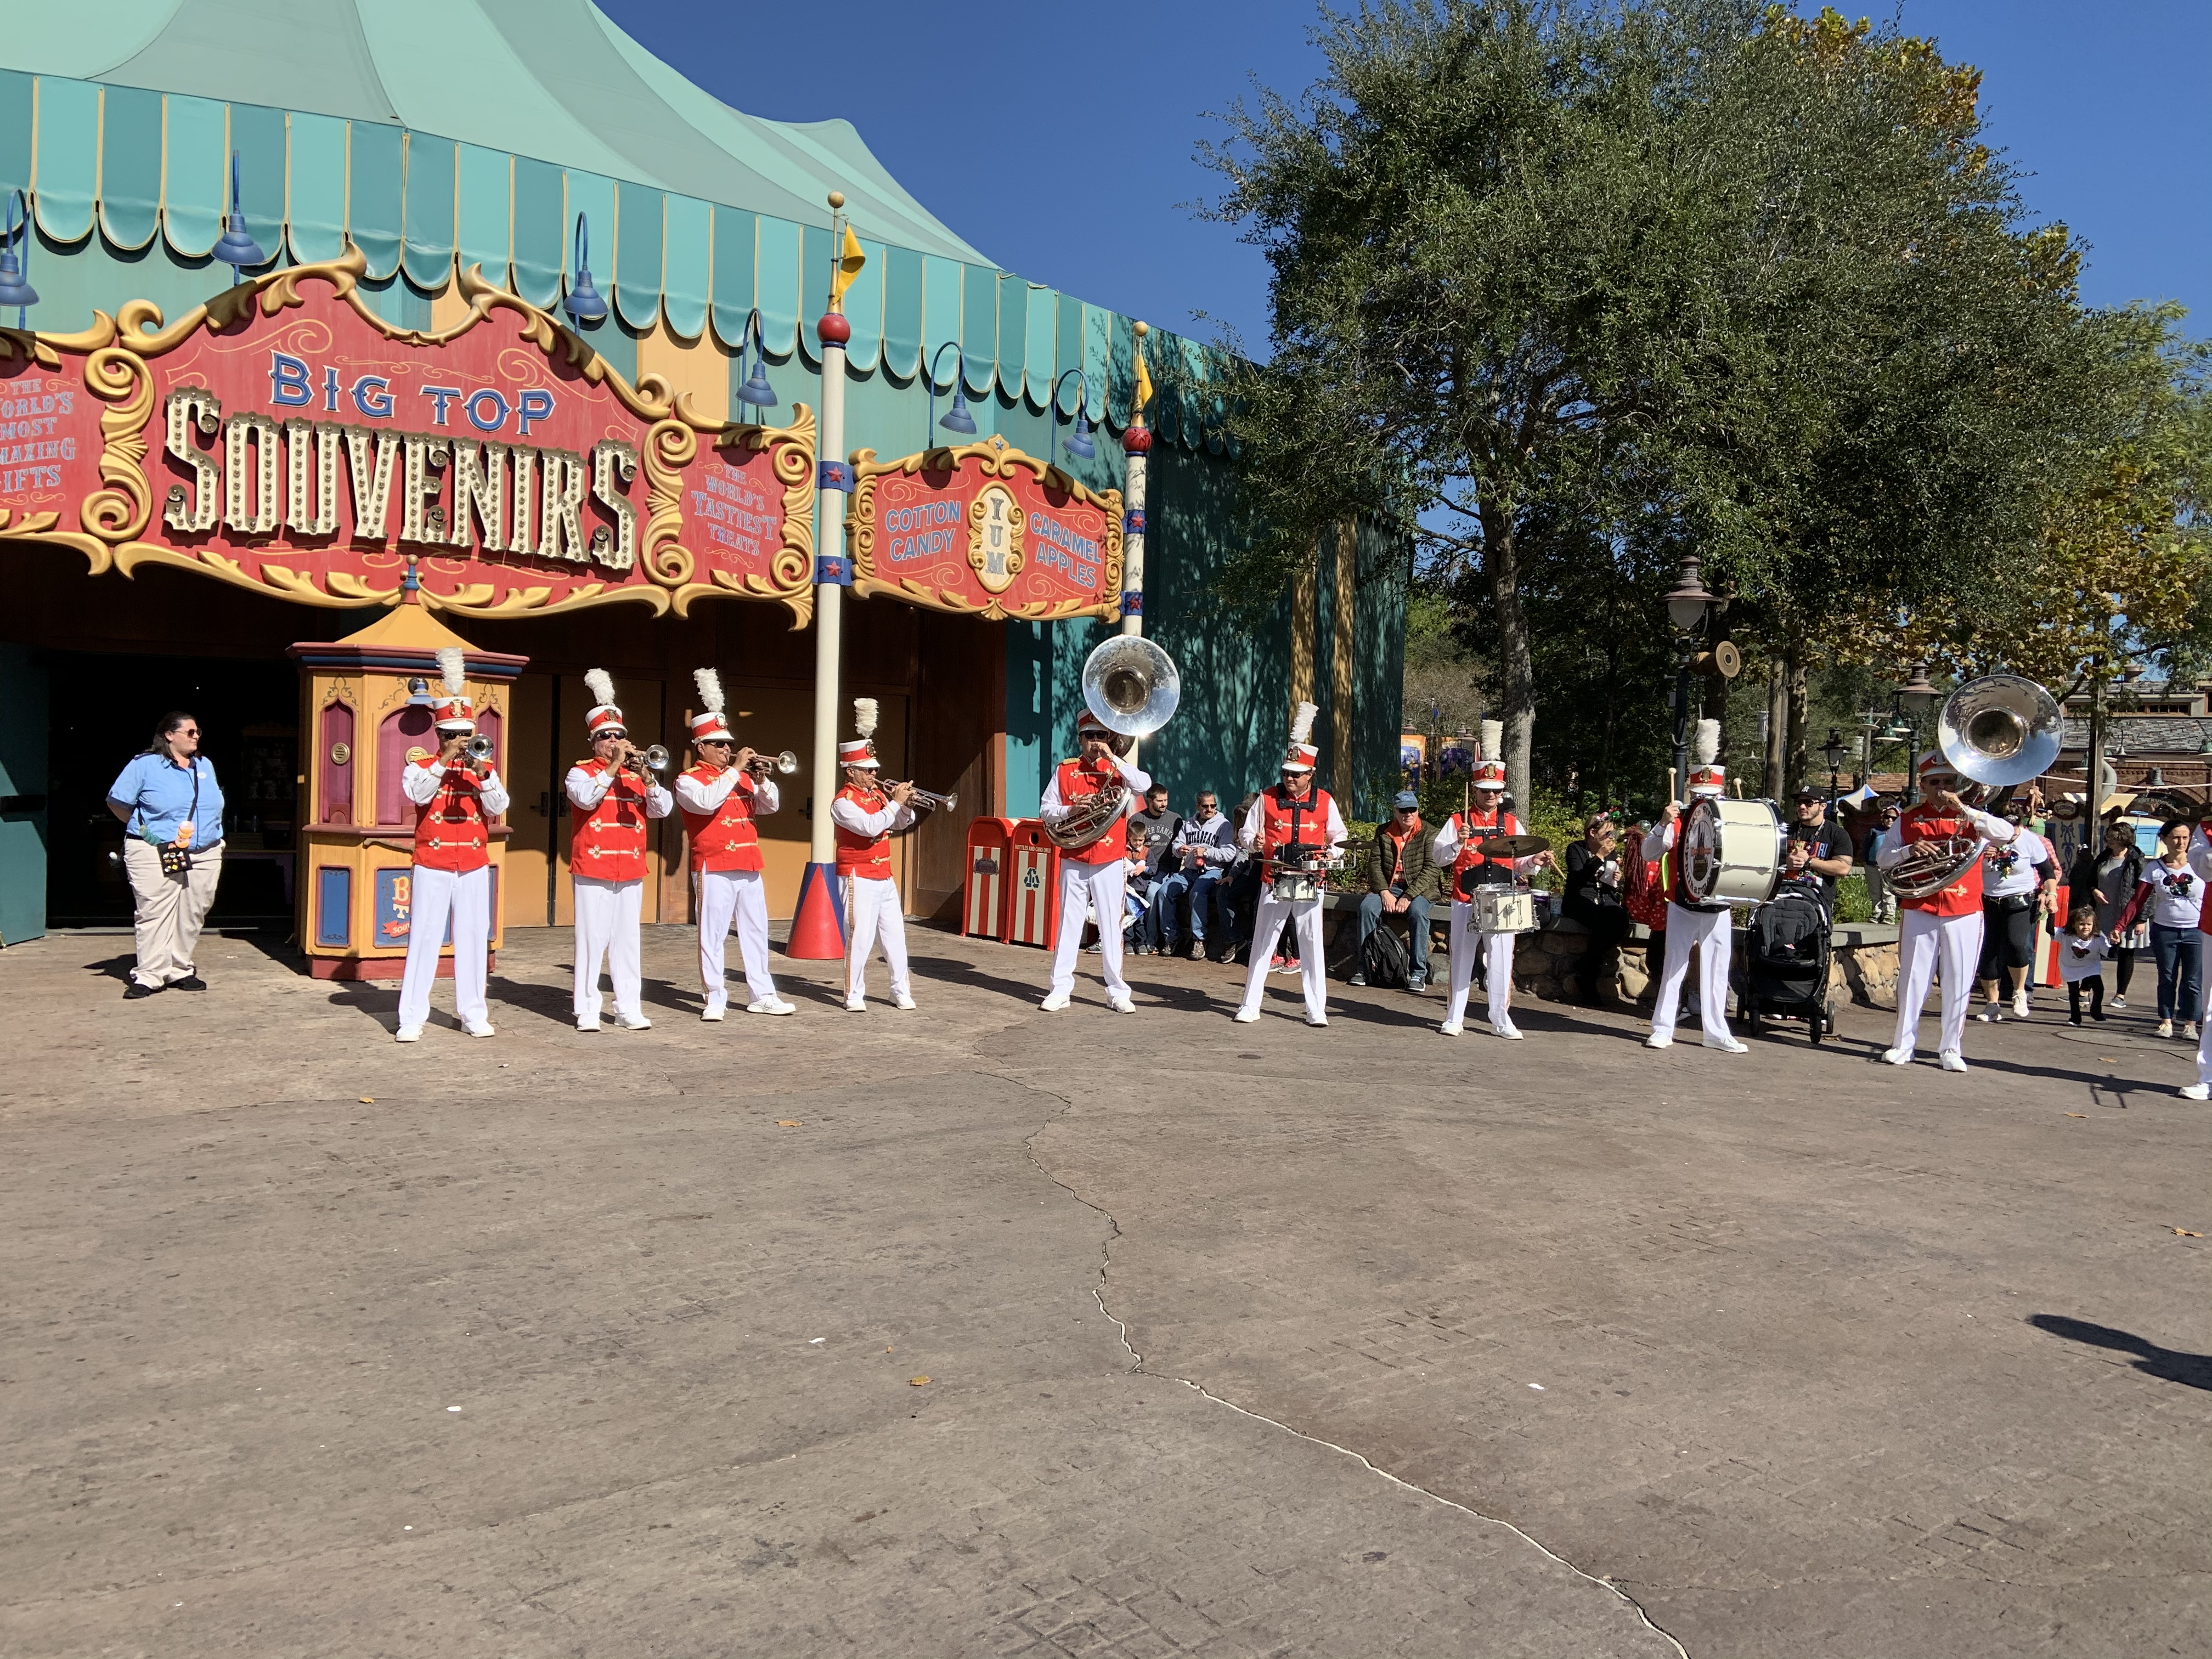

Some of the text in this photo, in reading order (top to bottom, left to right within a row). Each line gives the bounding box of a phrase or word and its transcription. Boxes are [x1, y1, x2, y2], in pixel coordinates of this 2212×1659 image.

[10, 379, 42, 395] THE
[268, 349, 557, 436] BIG TOP
[0, 392, 74, 419] ORLD'S
[0, 417, 57, 441] MOST
[0, 465, 61, 493] IFTS
[164, 386, 638, 572] SOUVENIRS
[724, 464, 747, 485] THE
[705, 475, 764, 511] WORLD'S
[691, 490, 777, 540] TASTIEST
[885, 500, 961, 533] COTTON
[708, 522, 759, 556] TREATS
[890, 528, 956, 562] CANDY
[985, 496, 1005, 575] YUM
[1030, 512, 1101, 564] CARAMEL
[1035, 541, 1096, 589] APPLES
[1156, 826, 1173, 839] BANKS
